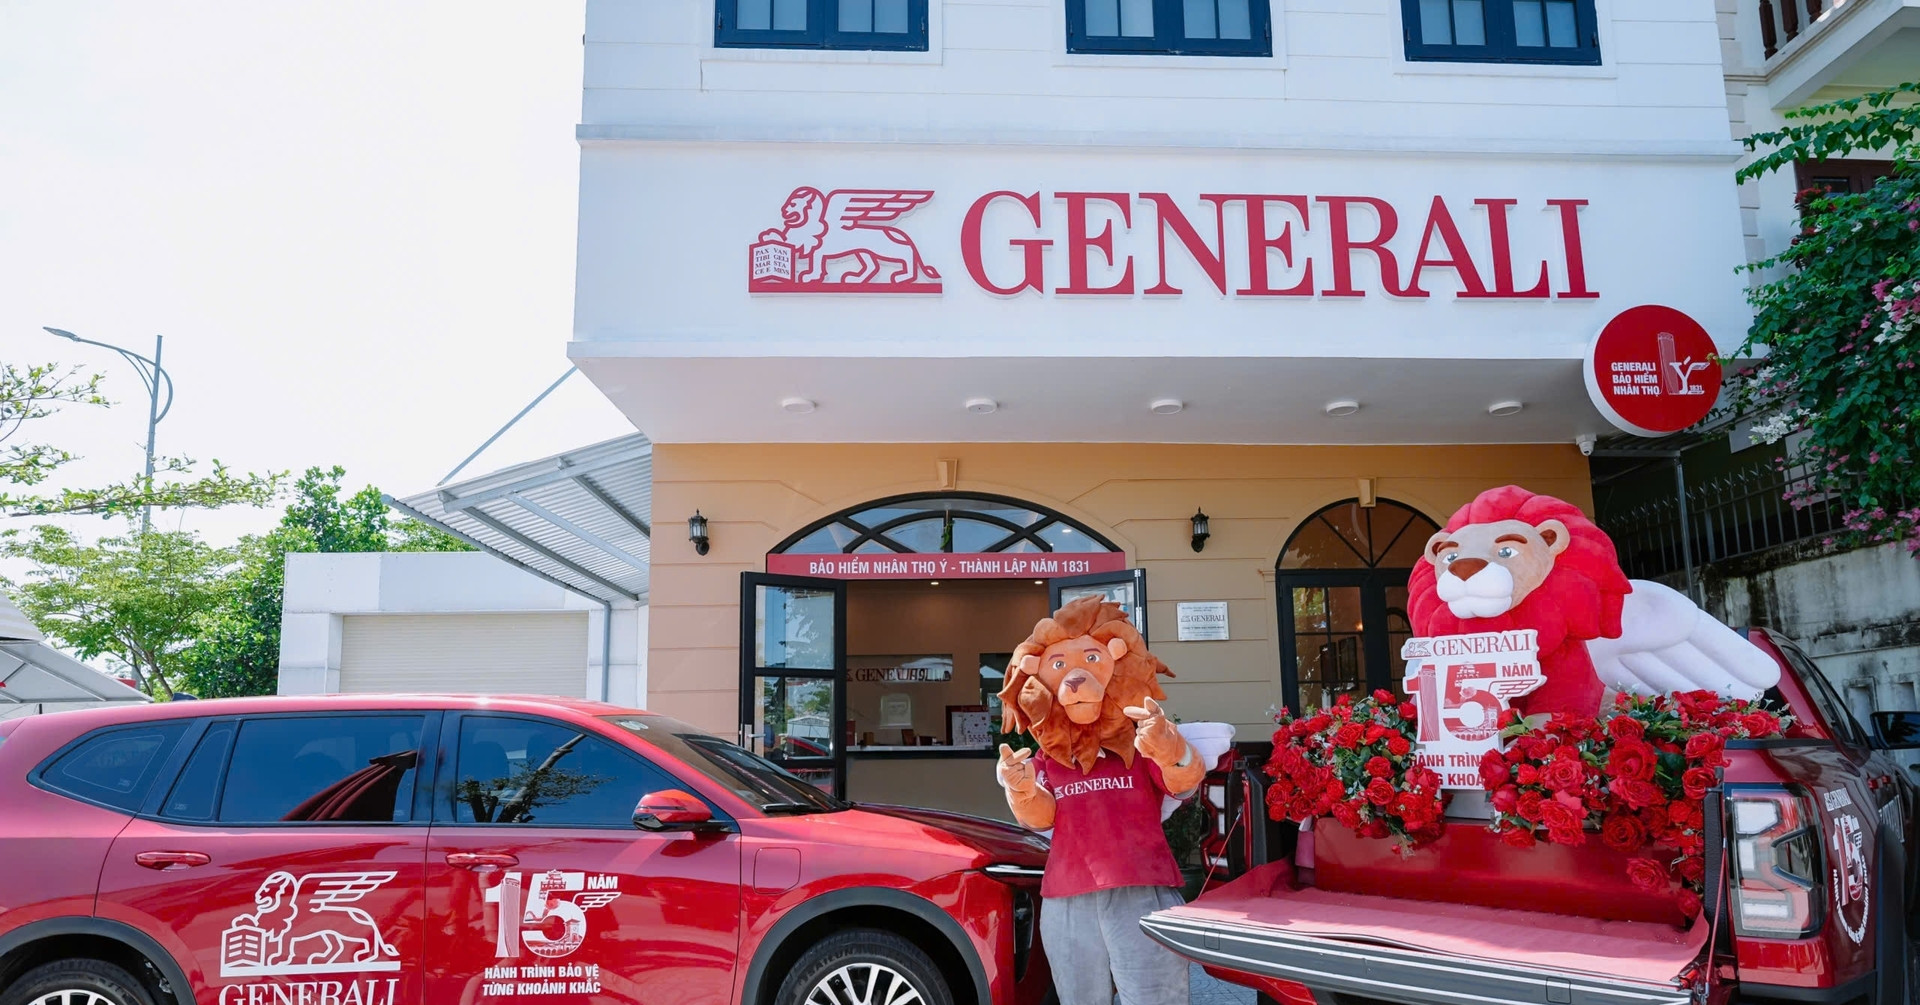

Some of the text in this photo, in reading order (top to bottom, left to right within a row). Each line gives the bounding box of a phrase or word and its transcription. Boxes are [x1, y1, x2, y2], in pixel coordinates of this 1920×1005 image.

[960, 190, 1600, 298] GENERALI
[773, 260, 787, 268] STA
[1611, 361, 1657, 372] GENERALI
[1612, 371, 1632, 384] BẢO
[1613, 383, 1660, 397] NHÂN THỌ
[809, 558, 835, 574] BẢO
[838, 556, 870, 574] HIỂM
[873, 558, 908, 574] NHÂN
[911, 560, 936, 576] THỌ
[939, 558, 948, 574] Ý
[959, 558, 1001, 573] THÀNH
[1004, 557, 1028, 576] LẬP
[1030, 558, 1058, 573] NĂM
[1061, 560, 1090, 573] 1831
[1191, 614, 1225, 622] GENERALI
[1433, 633, 1532, 657] GENERALI
[1406, 662, 1533, 743] 15 NĂM
[1448, 752, 1484, 767] TRÌN
[1064, 775, 1134, 796] GENERALI
[485, 869, 618, 958] 15 NĂM
[484, 962, 600, 980] HÀNH TRÌNH BẢO VỆ
[218, 978, 400, 1005] GENERALI
[482, 978, 602, 996] TỪNG KHOẢNH KHẮC
